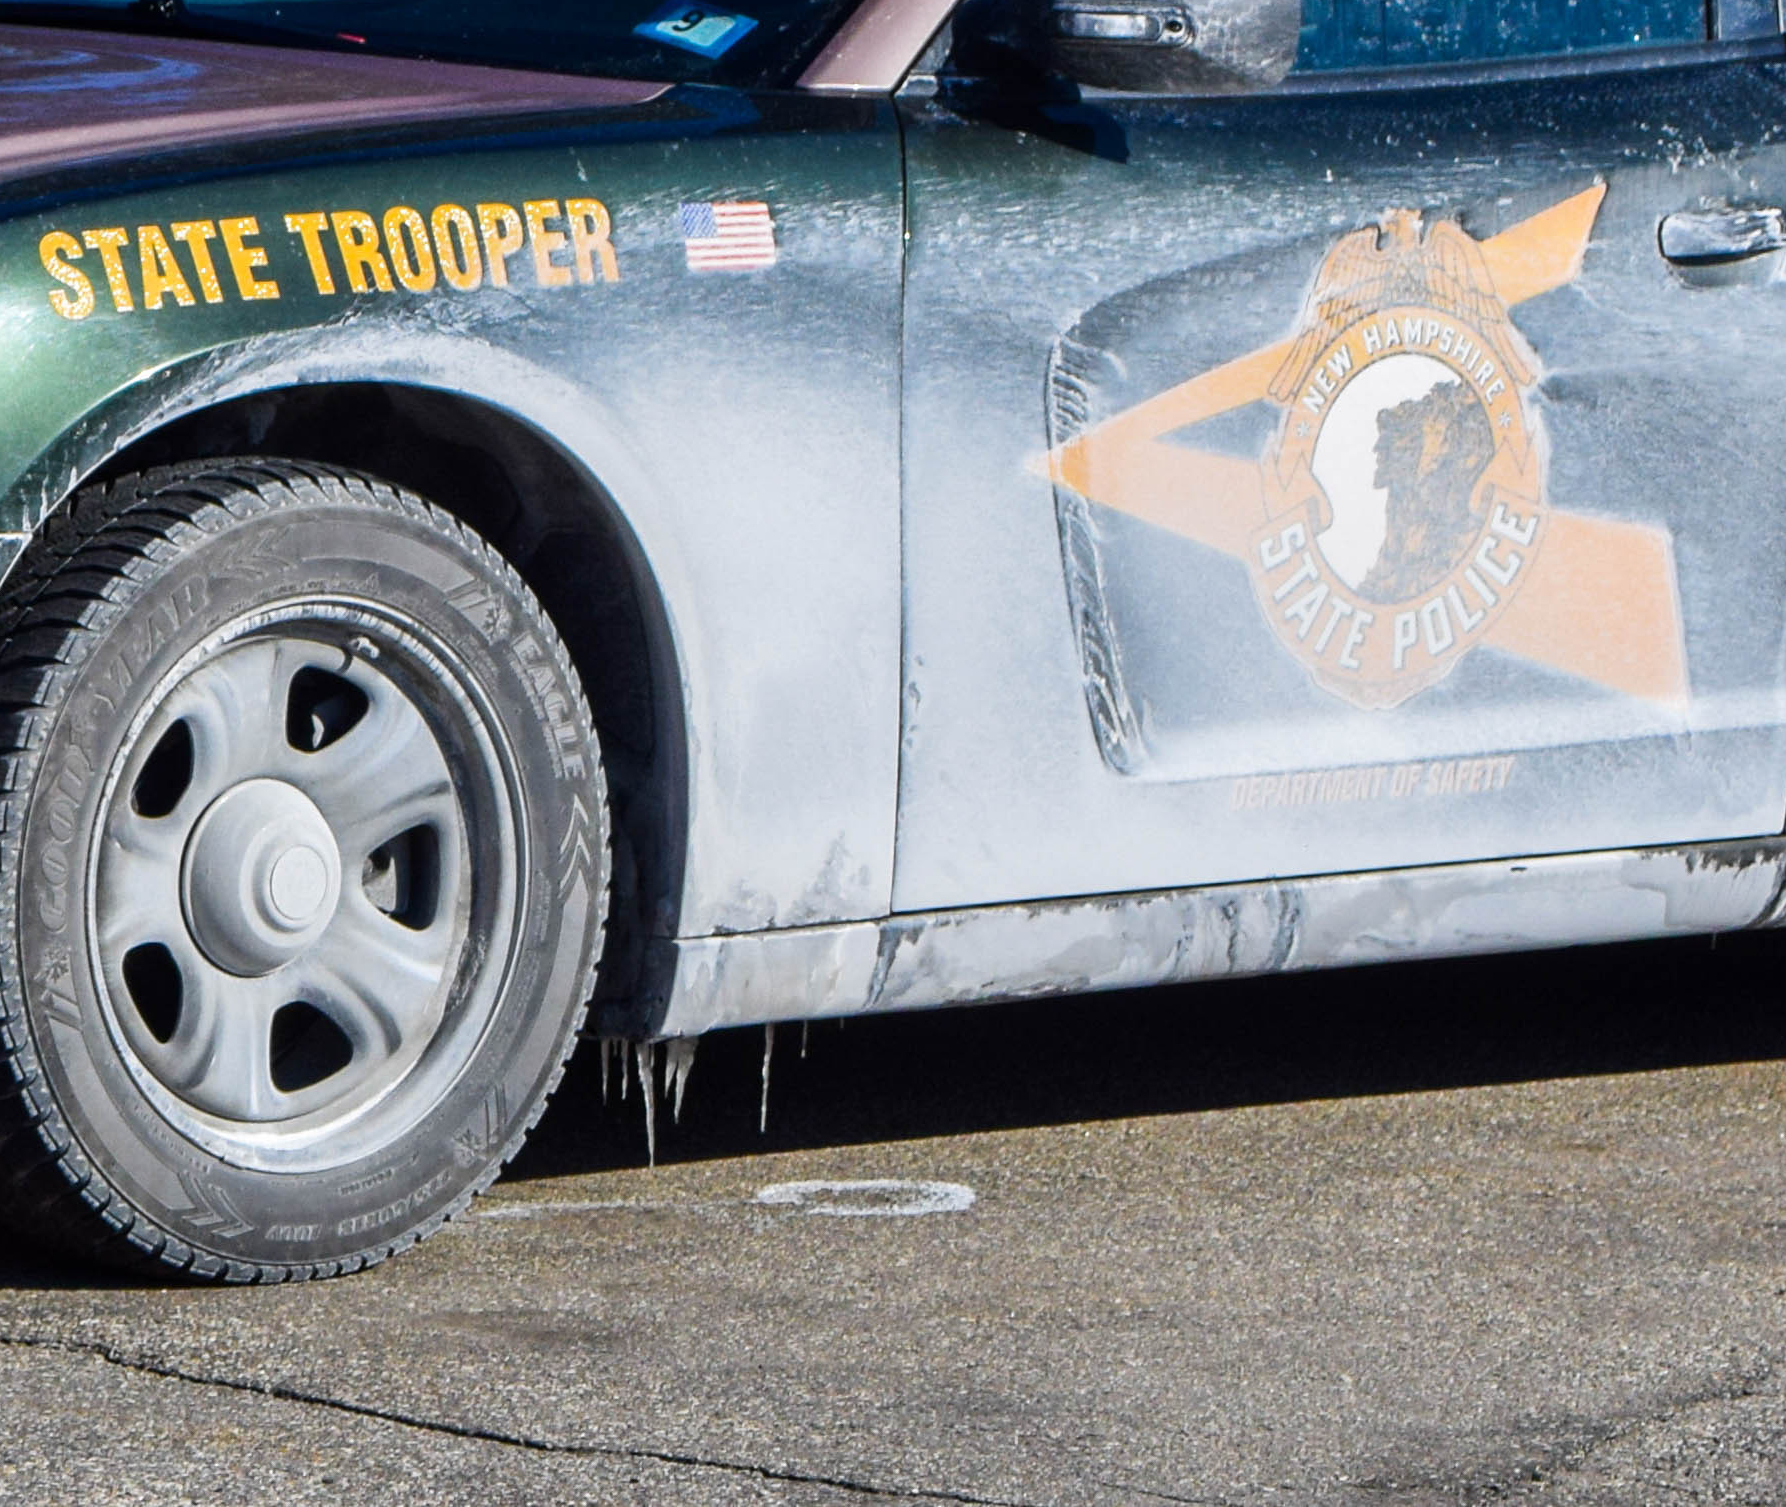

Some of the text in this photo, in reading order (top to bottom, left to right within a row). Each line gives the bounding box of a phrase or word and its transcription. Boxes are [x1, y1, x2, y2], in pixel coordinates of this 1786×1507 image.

[671, 9, 706, 32] 9
[38, 197, 620, 321] STATE TROOPER
[1301, 316, 1506, 413] NEW HAMPSHIRE
[1259, 501, 1540, 671] STATE POLICE
[511, 630, 587, 781] EAGLE
[1229, 754, 1517, 811] DEPARTMENT OF SAFETY
